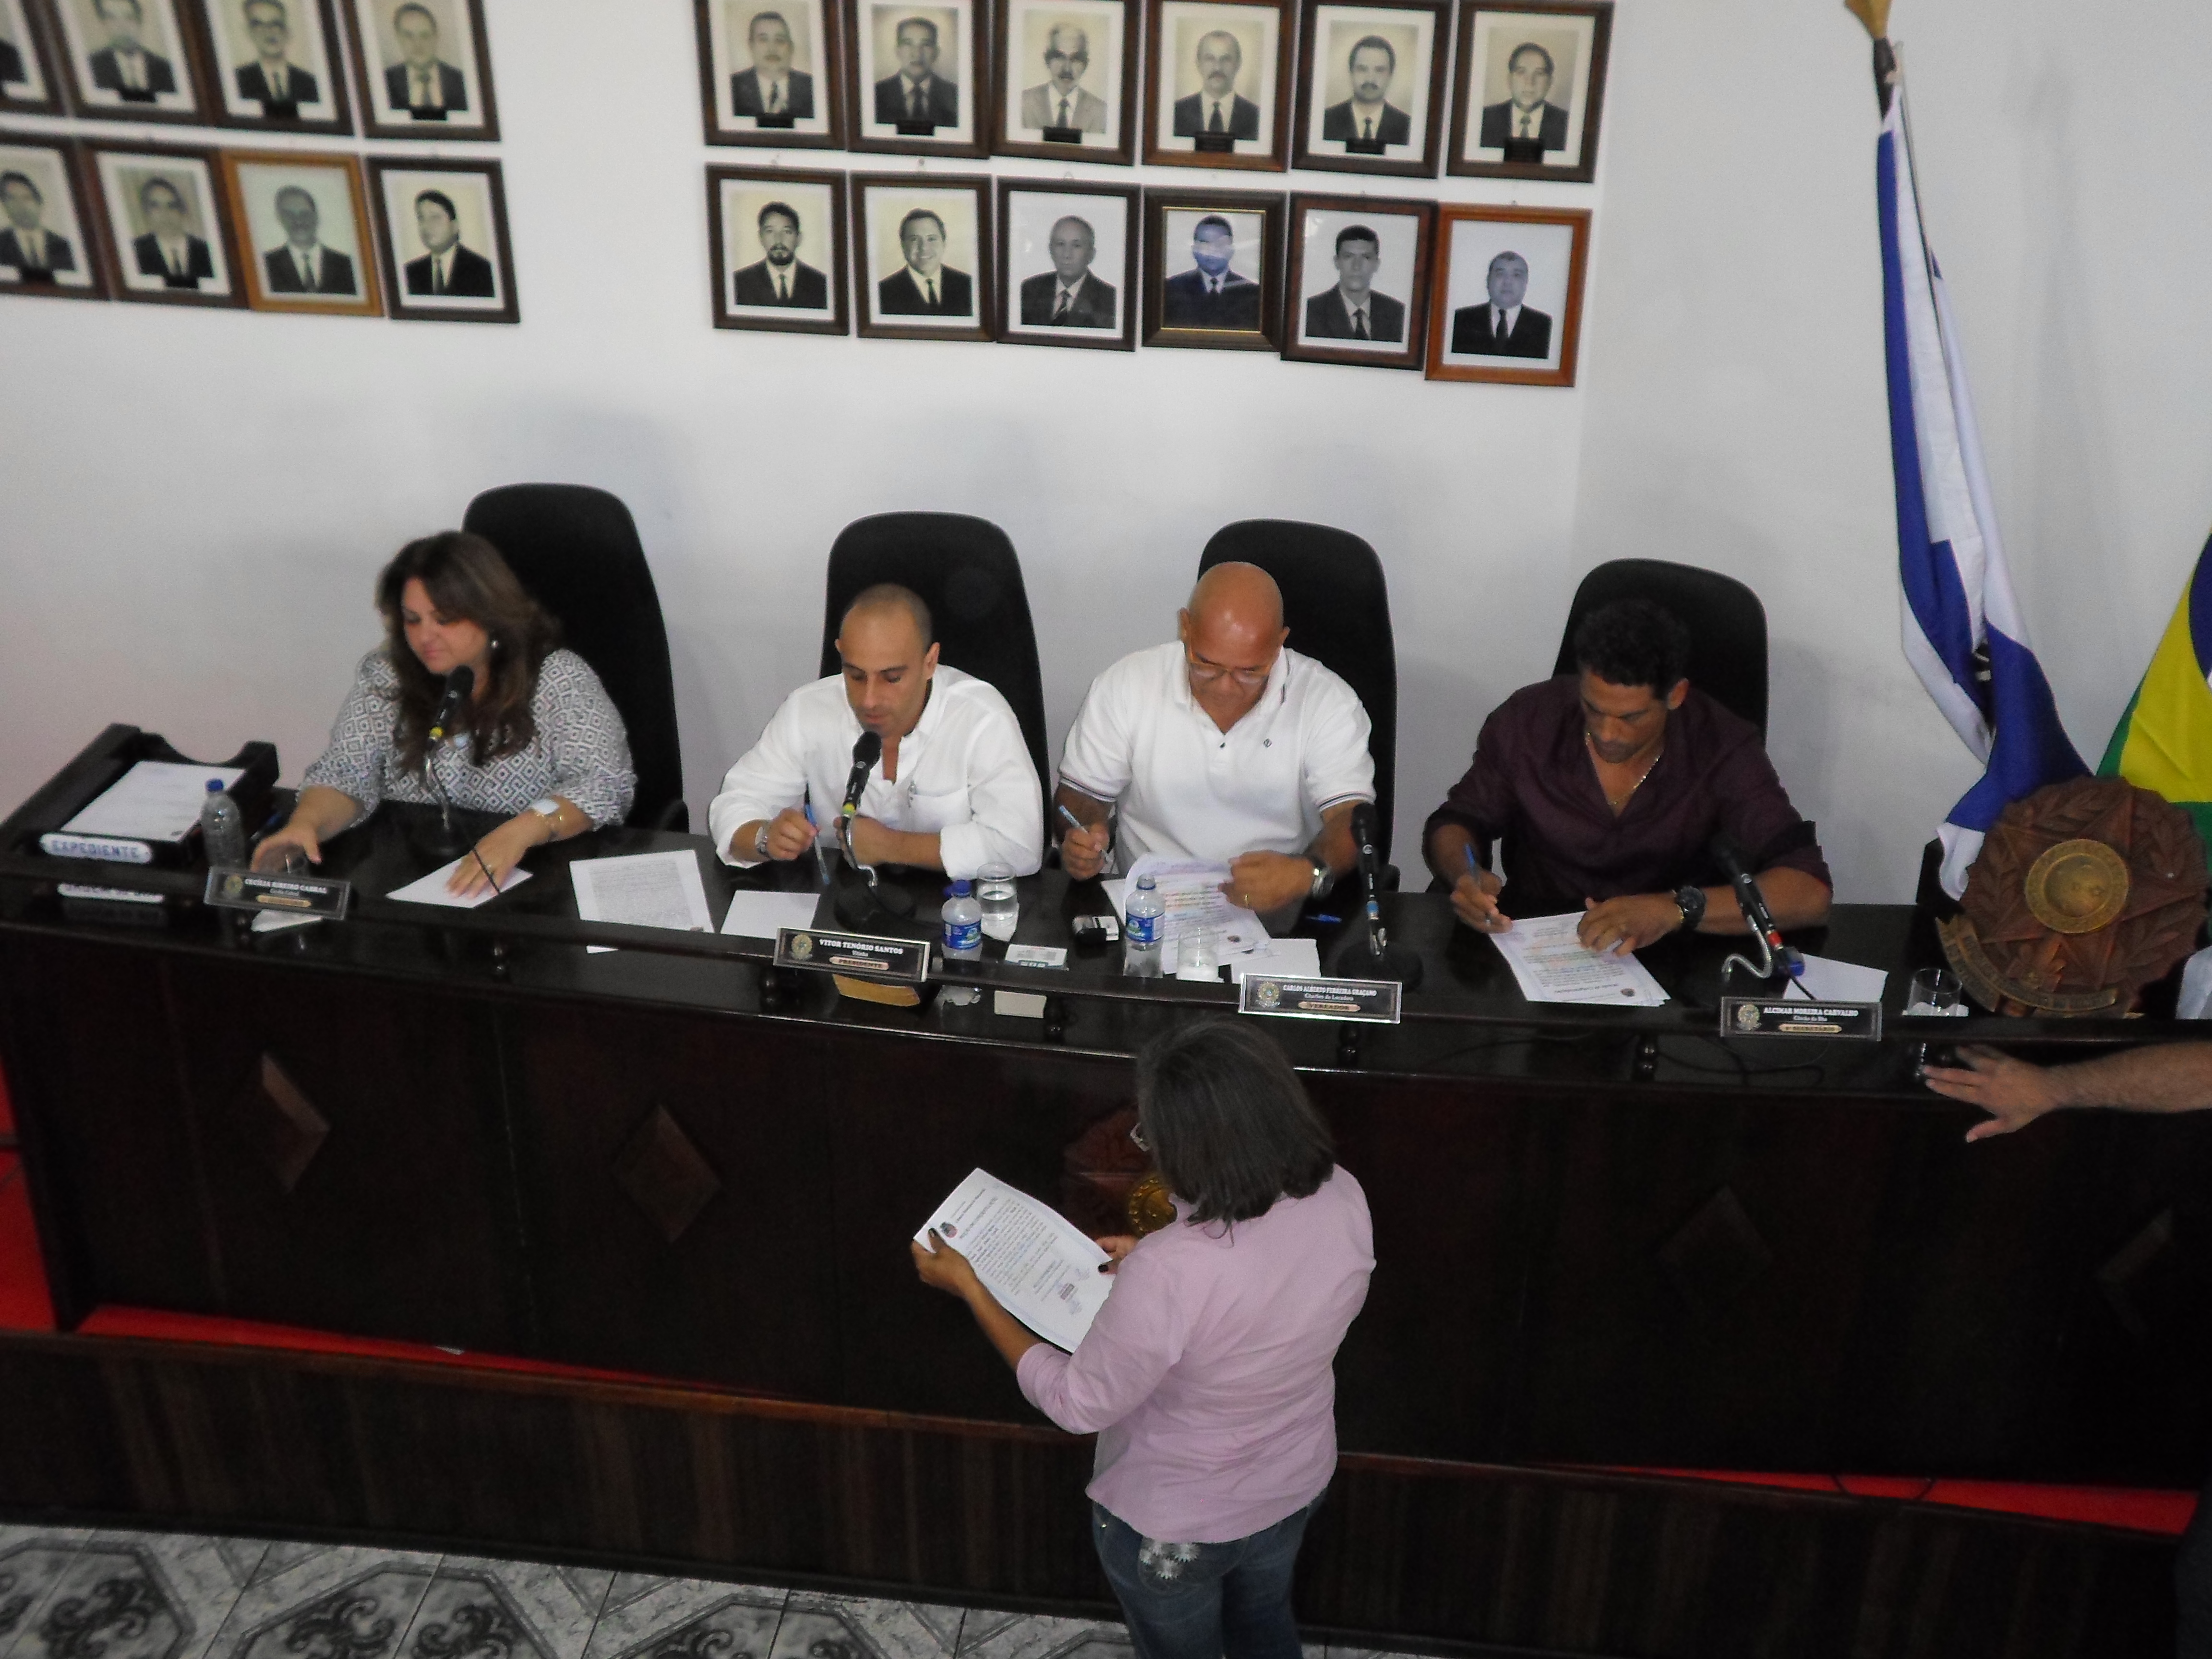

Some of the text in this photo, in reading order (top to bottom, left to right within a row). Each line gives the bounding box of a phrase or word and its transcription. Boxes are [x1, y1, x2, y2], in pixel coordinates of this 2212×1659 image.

[52, 841, 140, 858] EXPEDIENTE
[819, 939, 903, 955] VITOR TENÓRIO SANTOS
[839, 959, 882, 968] PRESIDENTE
